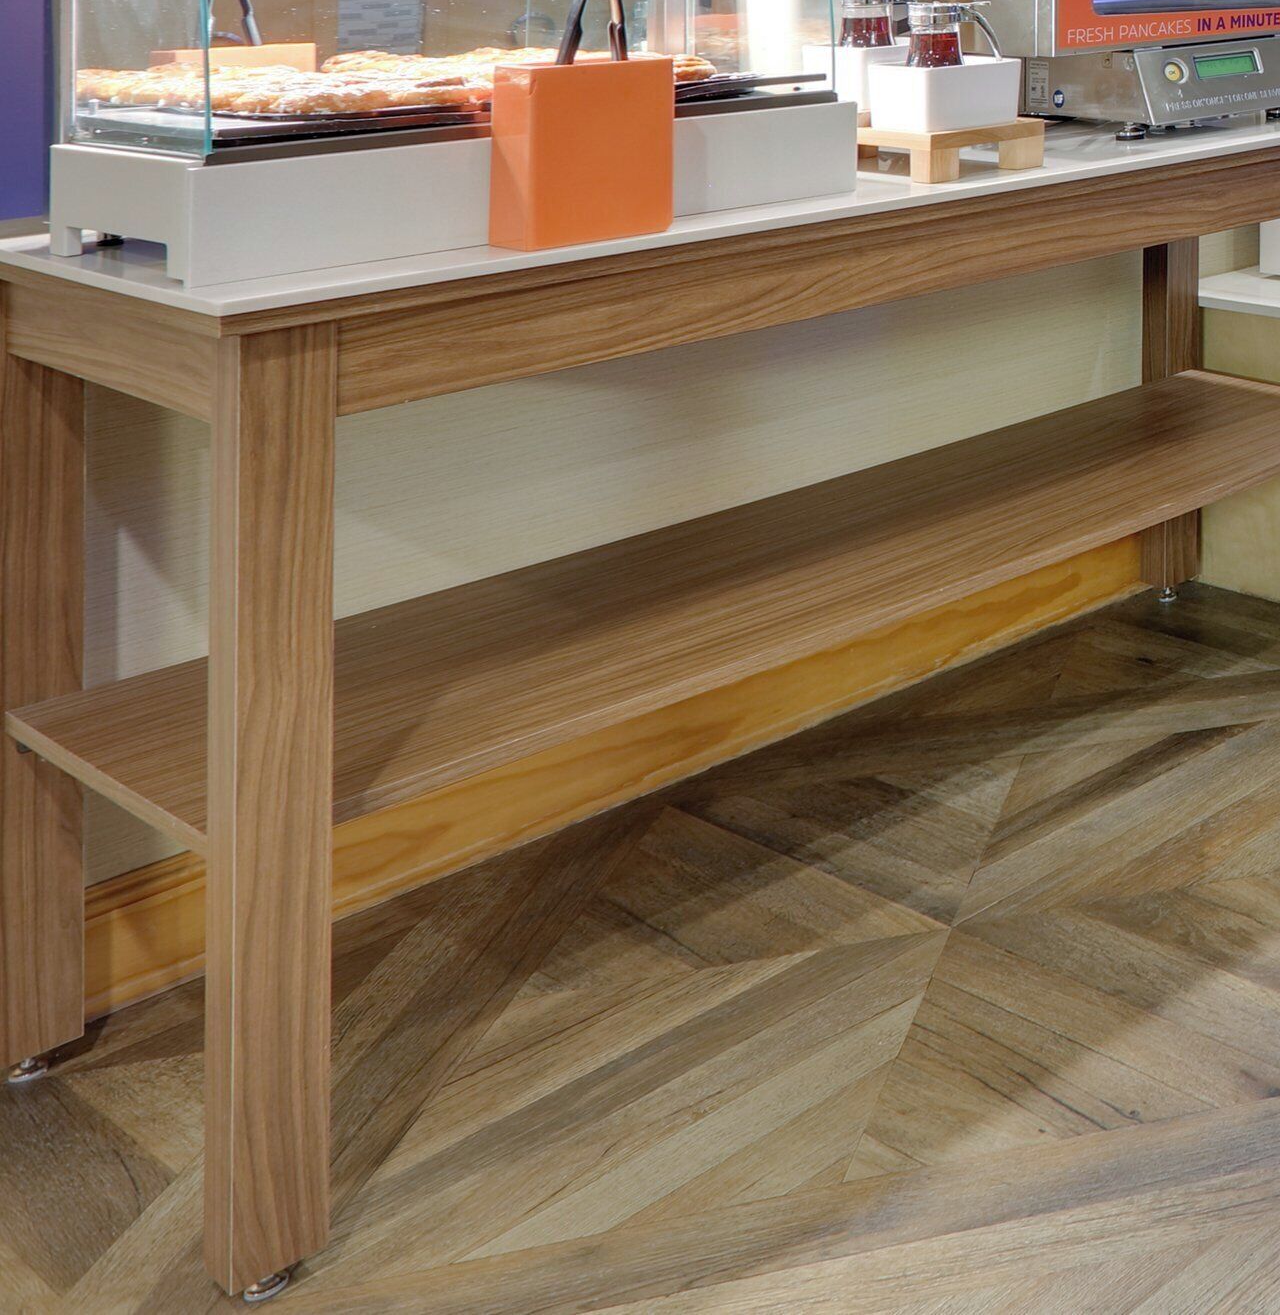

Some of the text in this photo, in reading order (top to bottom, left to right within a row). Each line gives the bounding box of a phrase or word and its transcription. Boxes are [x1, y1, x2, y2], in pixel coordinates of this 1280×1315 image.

[1067, 29, 1114, 45] FRESH
[1120, 19, 1192, 39] PANCAKES
[1197, 18, 1212, 32] IN
[1216, 17, 1226, 30] A
[1230, 13, 1280, 29] MINUTE
